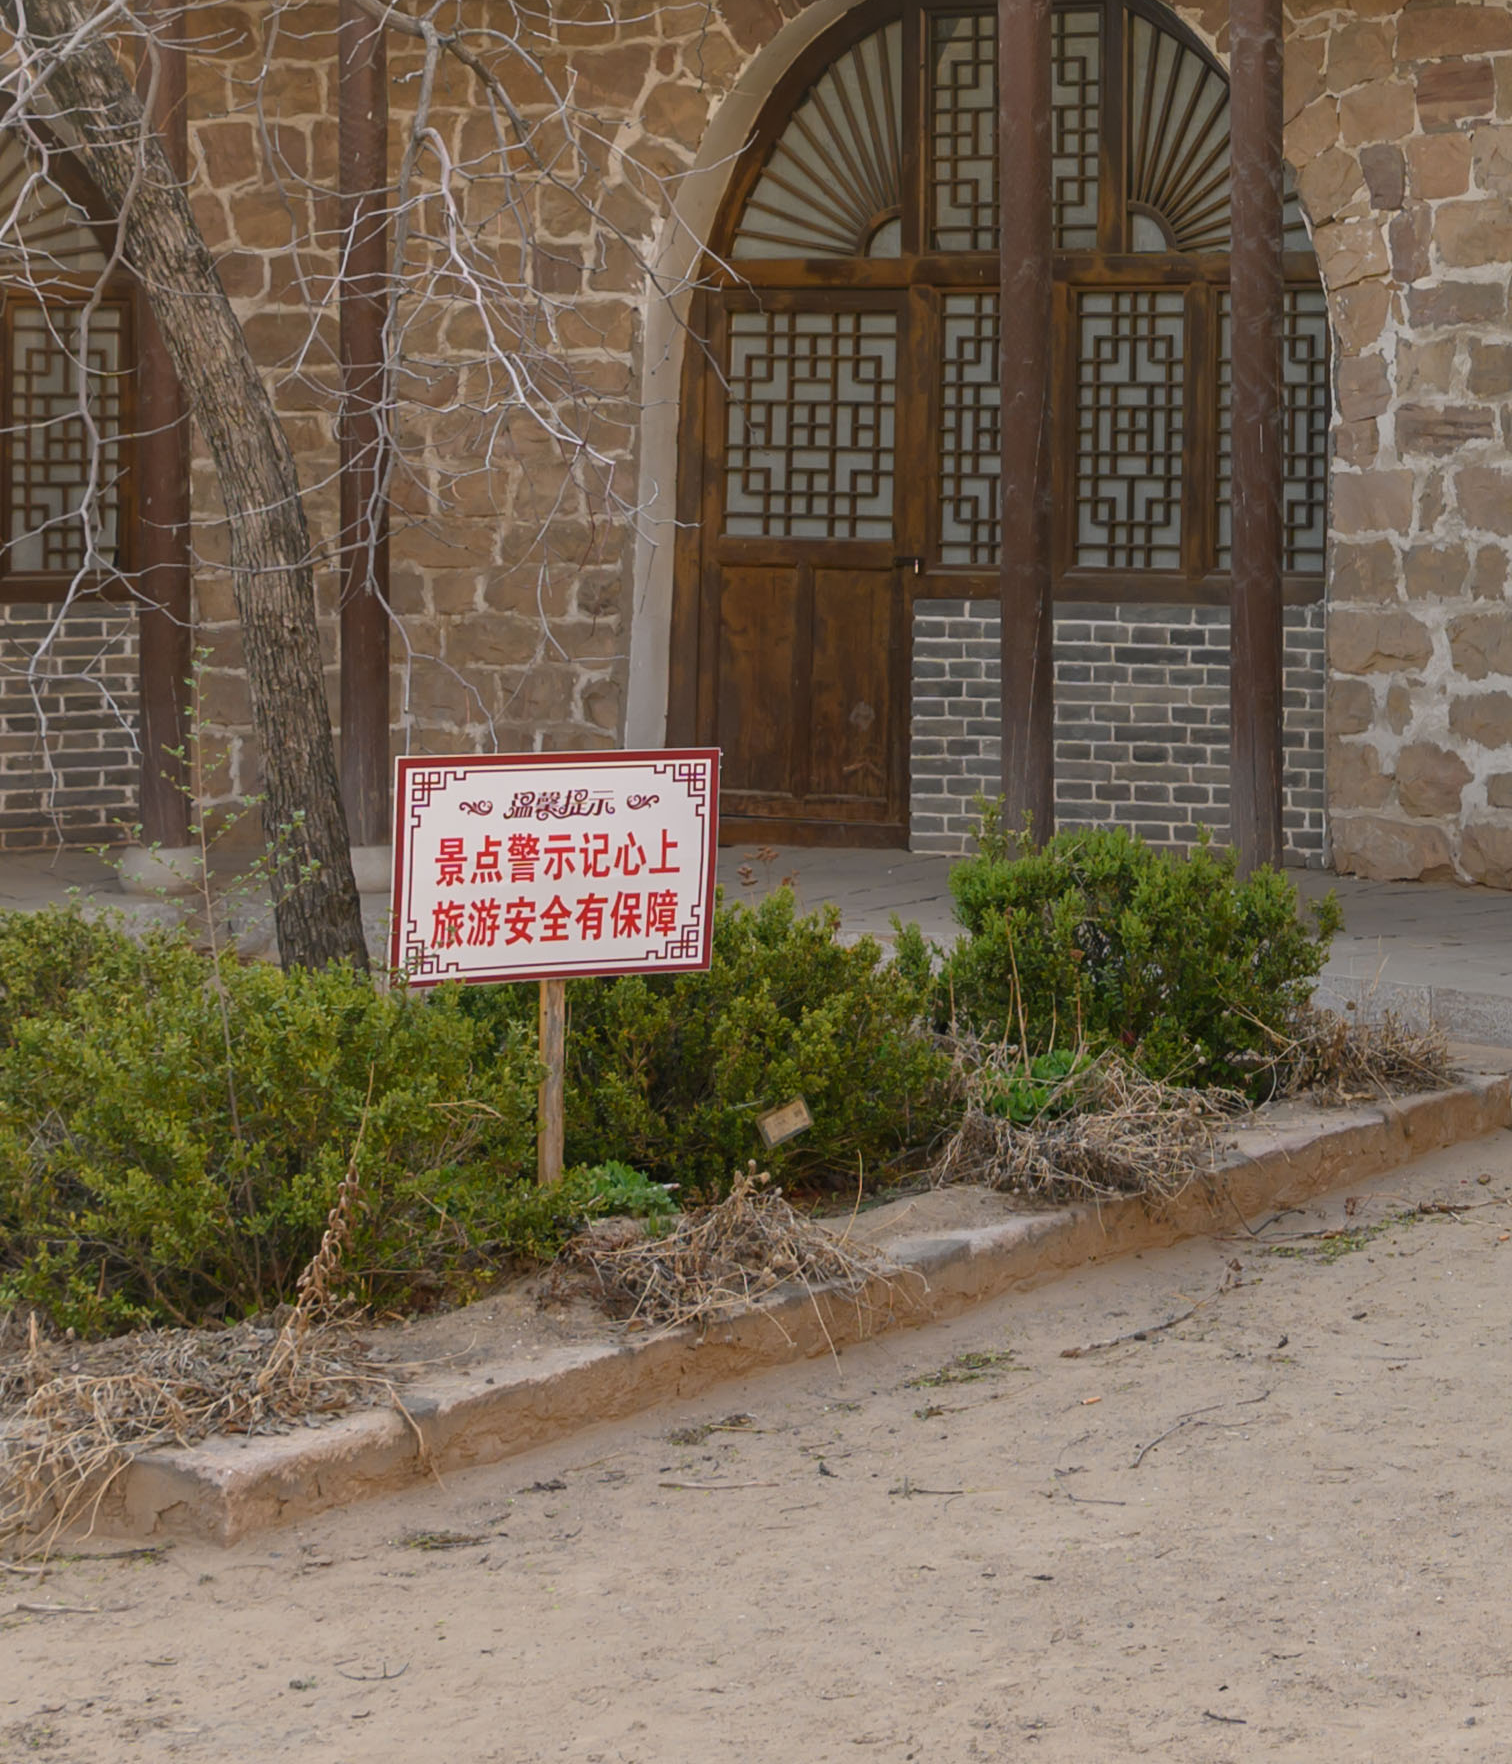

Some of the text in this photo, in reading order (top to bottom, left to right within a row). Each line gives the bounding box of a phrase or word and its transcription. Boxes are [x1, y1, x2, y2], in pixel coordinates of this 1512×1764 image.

[503, 789, 616, 821] 温馨提示
[435, 829, 681, 886] 景点警示记心上
[430, 889, 679, 949] 旅游安全有保障
